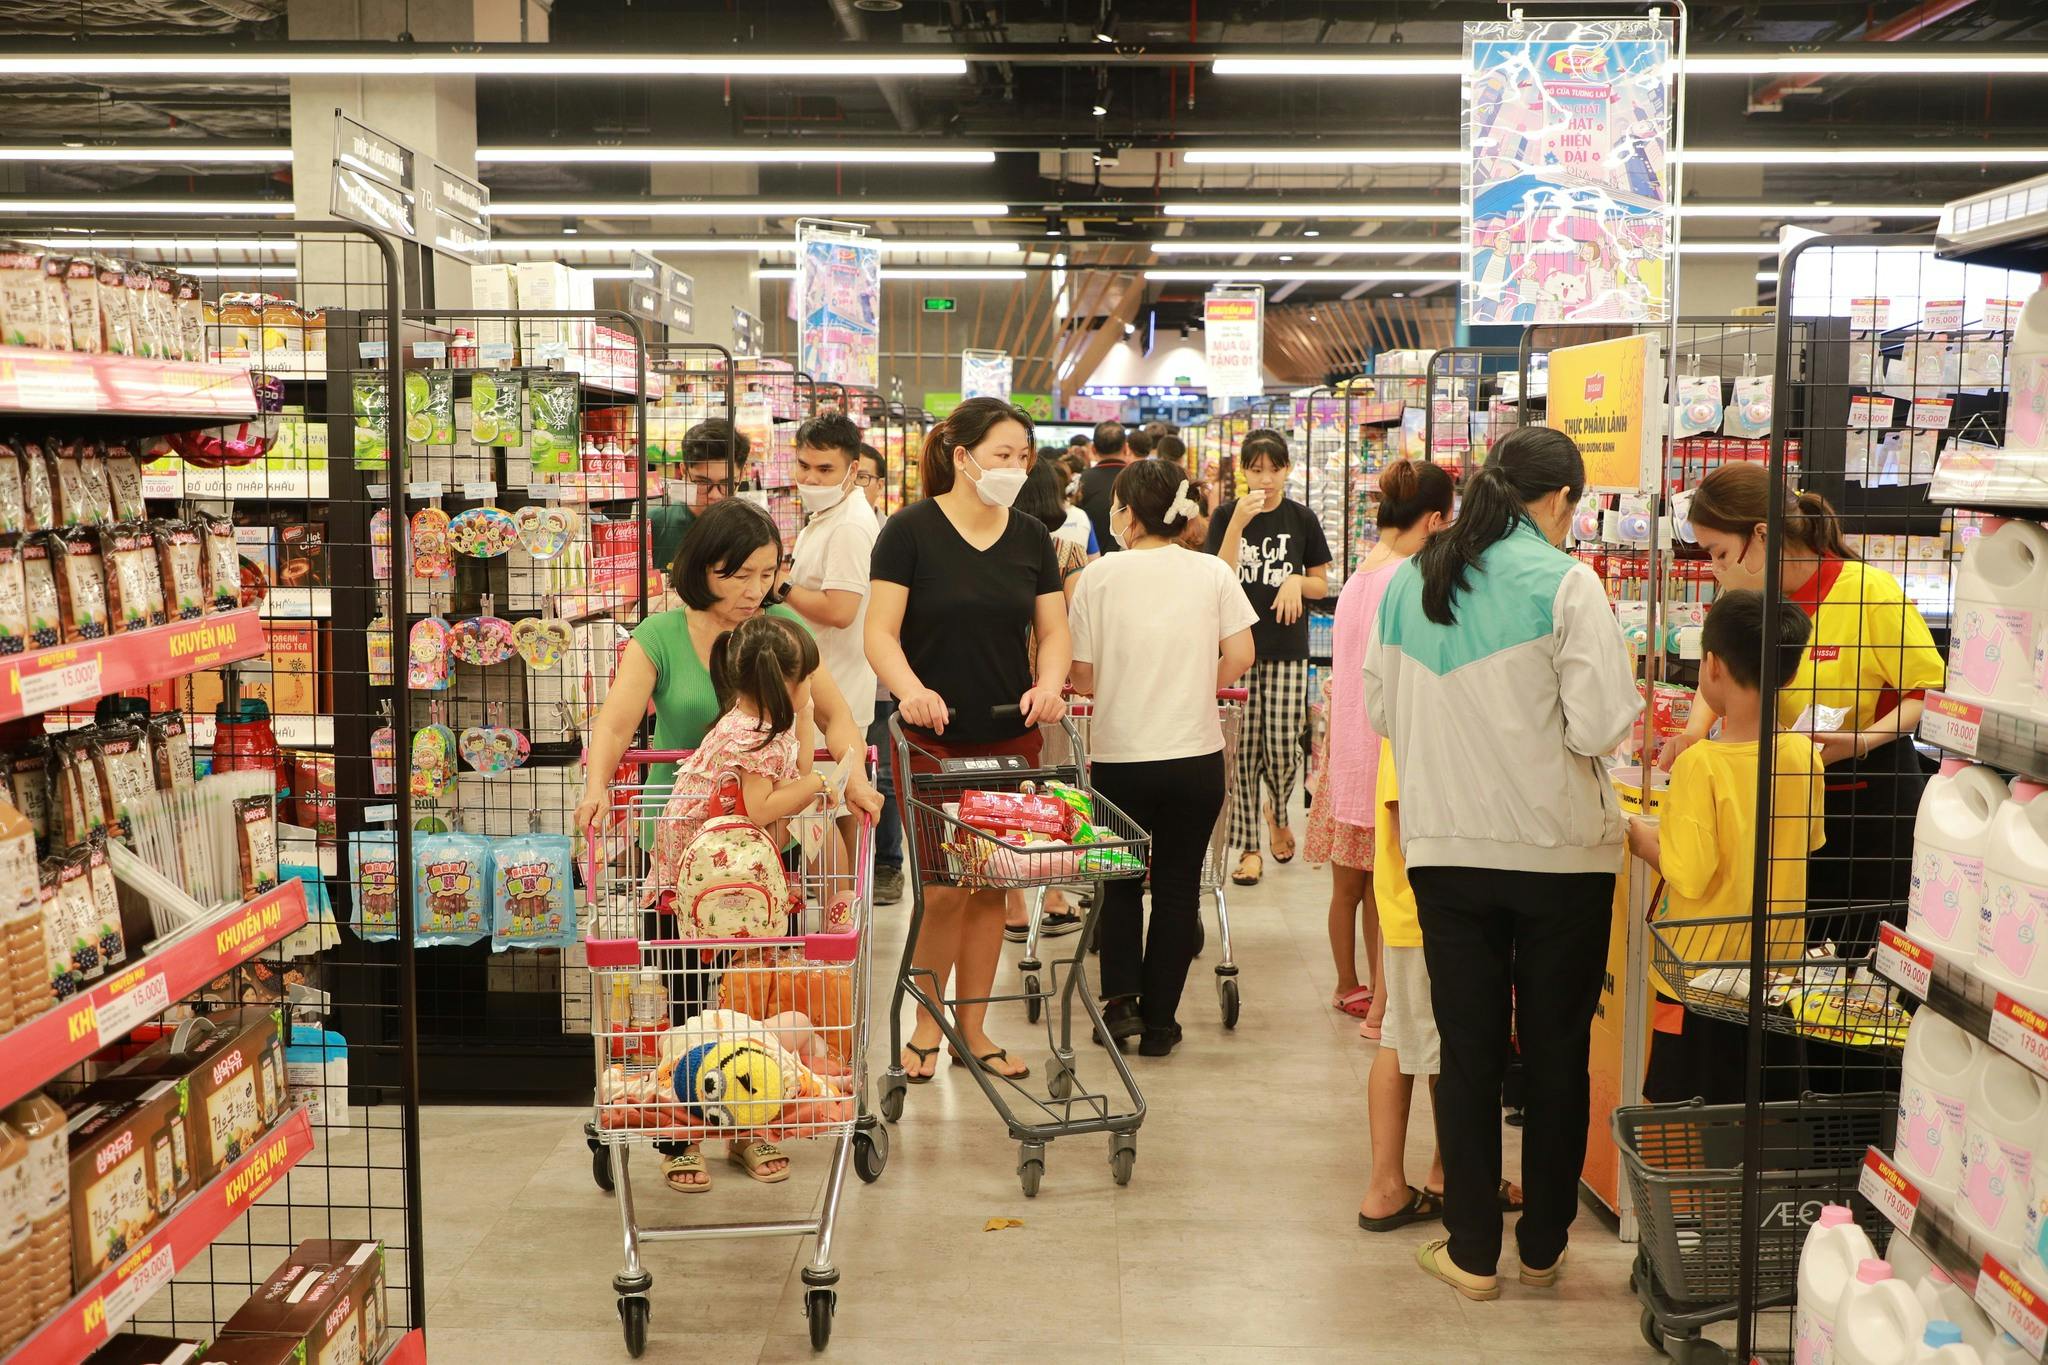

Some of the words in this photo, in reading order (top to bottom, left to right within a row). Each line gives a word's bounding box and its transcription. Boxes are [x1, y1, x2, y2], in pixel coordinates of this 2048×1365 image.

[170, 622, 215, 658] KHUYẾN
[216, 624, 237, 650] MẠI
[217, 909, 262, 955] KHUYẾN
[262, 901, 281, 929] MẠI
[225, 1152, 270, 1208] KHUYẾN
[268, 1136, 287, 1169] MẠI
